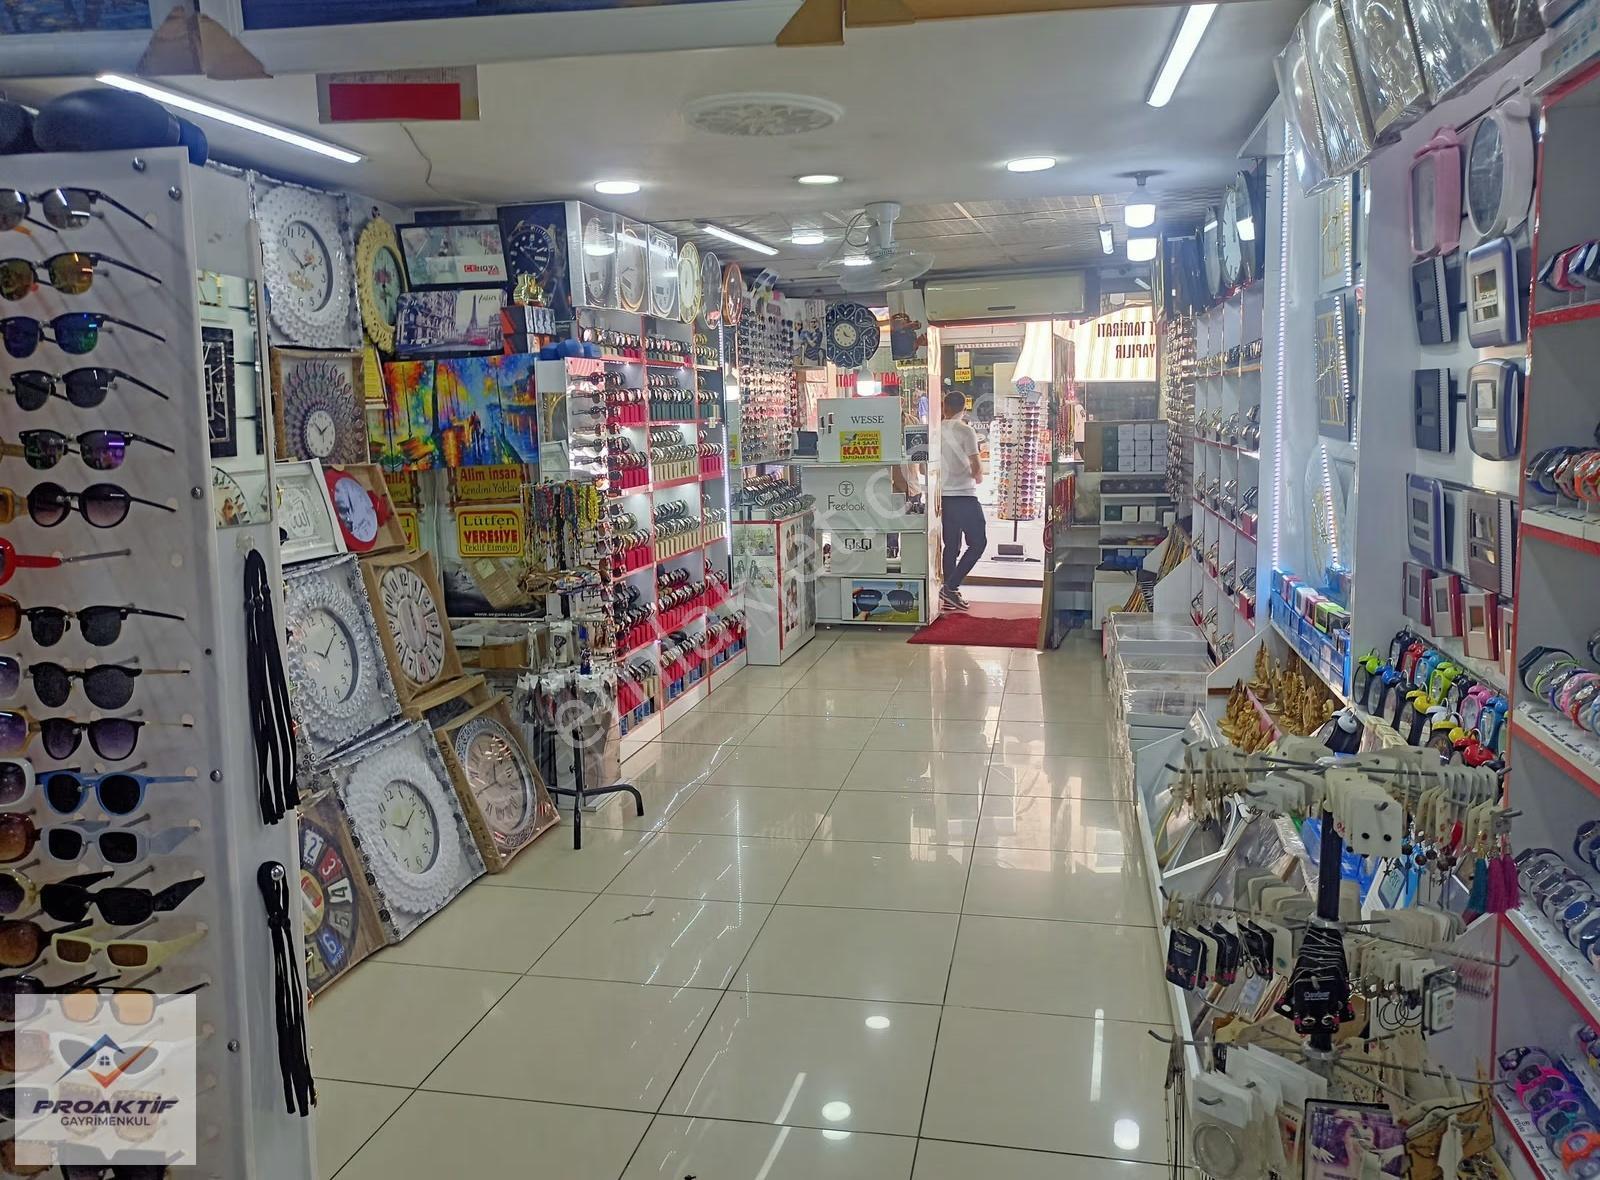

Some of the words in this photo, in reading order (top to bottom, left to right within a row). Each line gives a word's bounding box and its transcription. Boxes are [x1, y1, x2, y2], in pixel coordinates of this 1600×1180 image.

[851, 415, 885, 424] WESSE
[843, 446, 880, 456] KAYIT
[461, 467, 485, 481] Alim
[463, 515, 515, 527] Lütfen
[464, 527, 518, 544] VERESİYE
[844, 537, 872, 551] Q&Q
[321, 858, 336, 877] 3
[322, 933, 338, 954] 6
